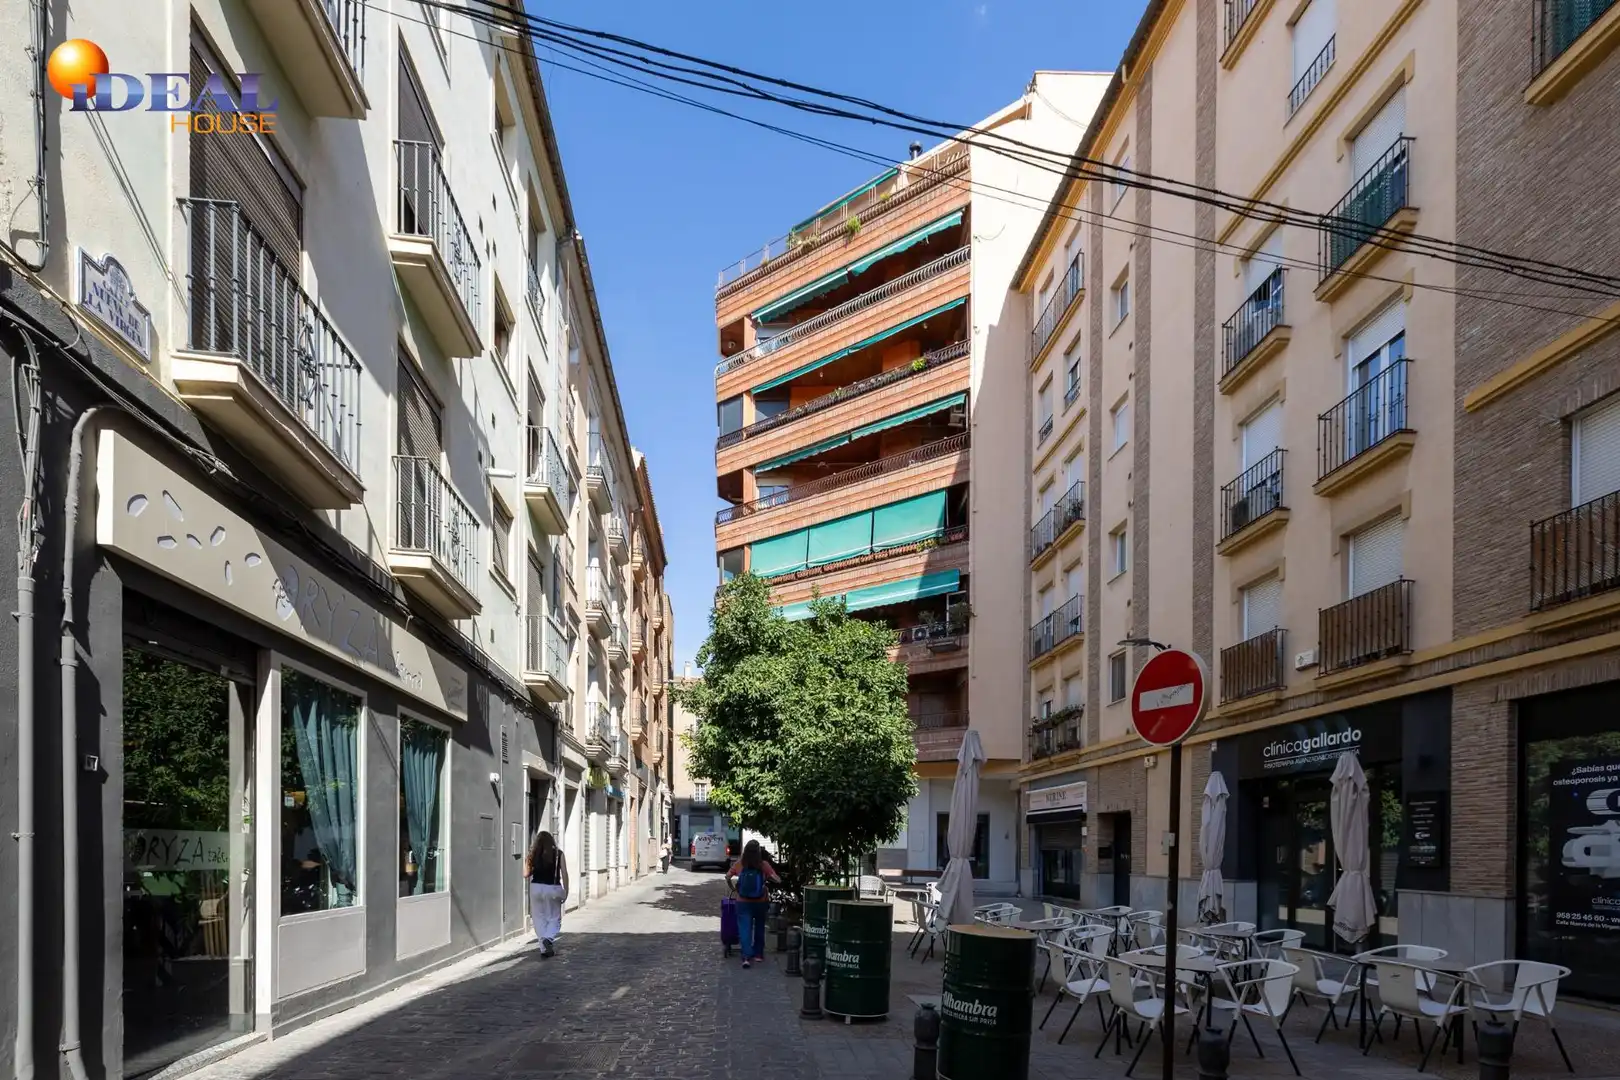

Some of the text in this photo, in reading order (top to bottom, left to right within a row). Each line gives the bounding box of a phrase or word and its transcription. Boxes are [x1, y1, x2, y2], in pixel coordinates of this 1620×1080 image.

[88, 291, 143, 348] LA VIRGEN
[92, 281, 141, 332] NUEVA DE
[1553, 775, 1619, 786] osteoporosis ya
